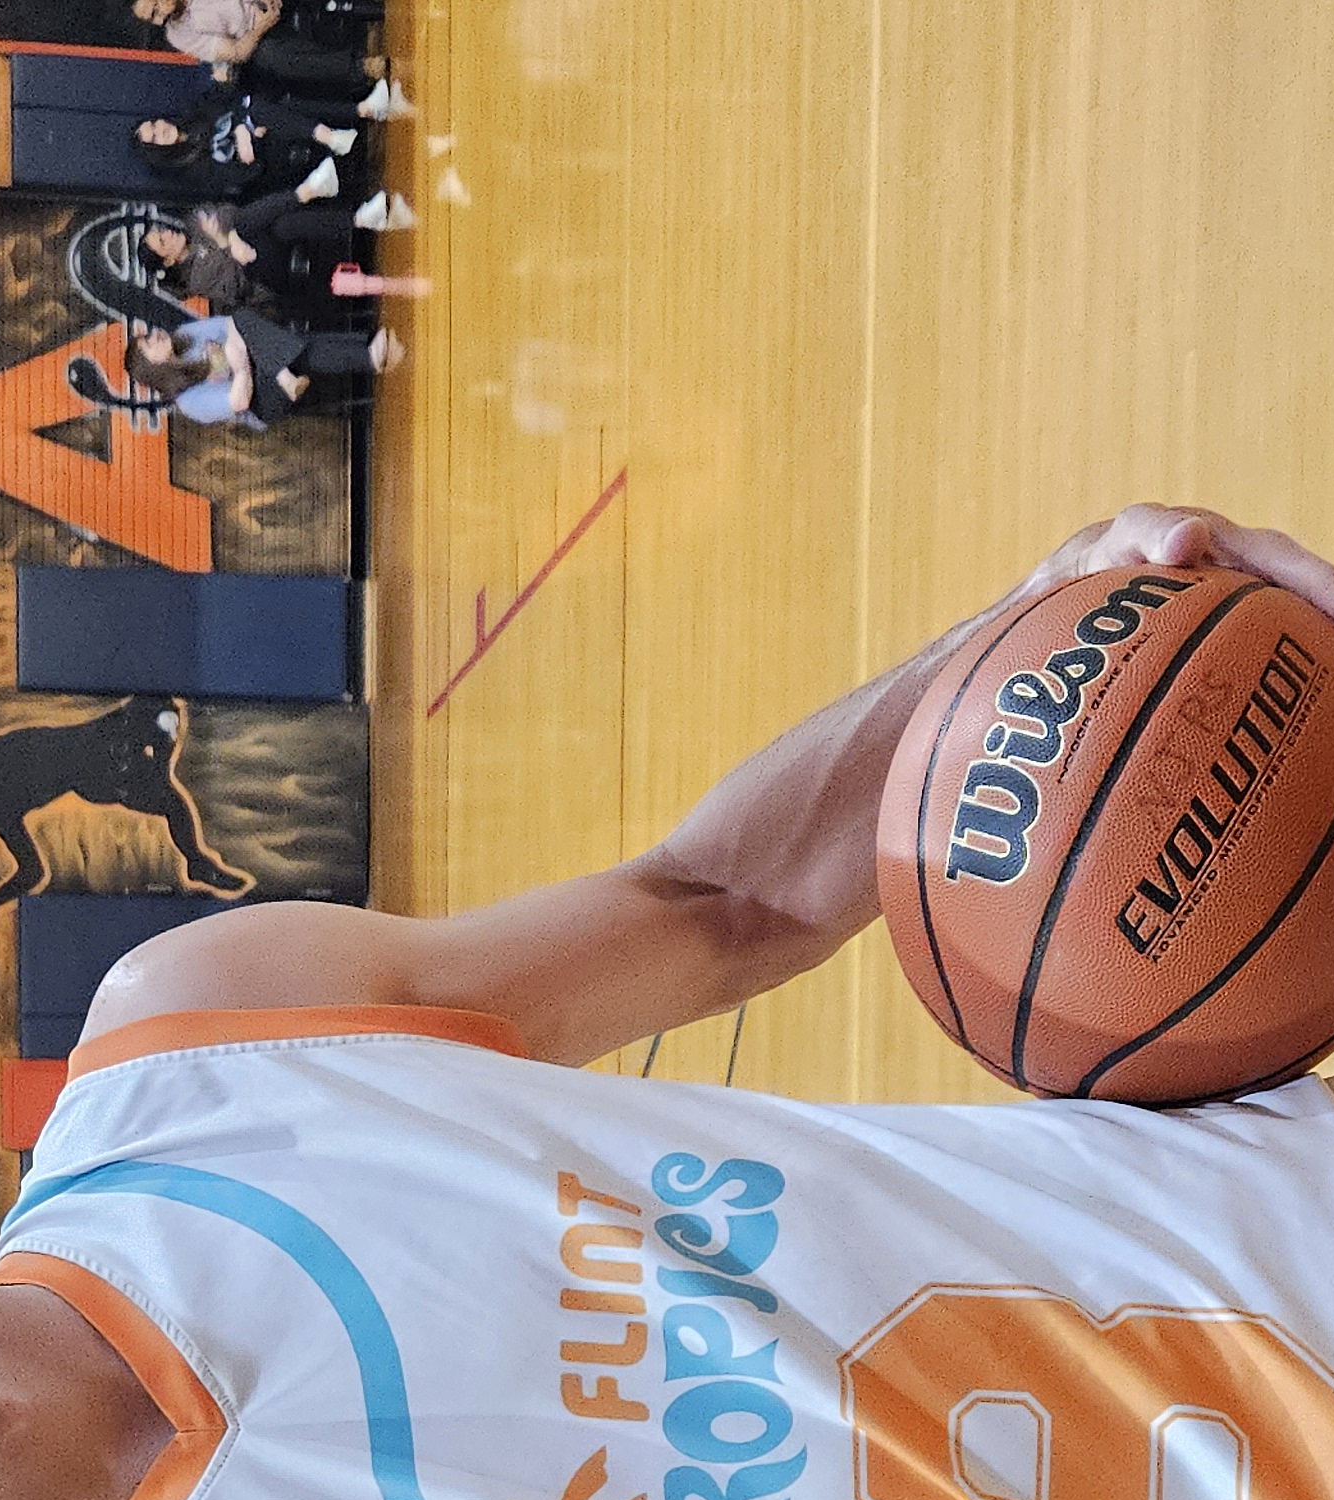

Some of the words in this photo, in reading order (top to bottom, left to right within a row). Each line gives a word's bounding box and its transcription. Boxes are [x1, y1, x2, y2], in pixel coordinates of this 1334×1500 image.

[945, 573, 1195, 885] Wilson
[1089, 666, 1123, 711] GAME
[1121, 632, 1153, 662] BALL
[1115, 633, 1315, 954] EVOLUTION
[1151, 869, 1218, 963] ADVANCED
[556, 1171, 648, 1422] FLINT
